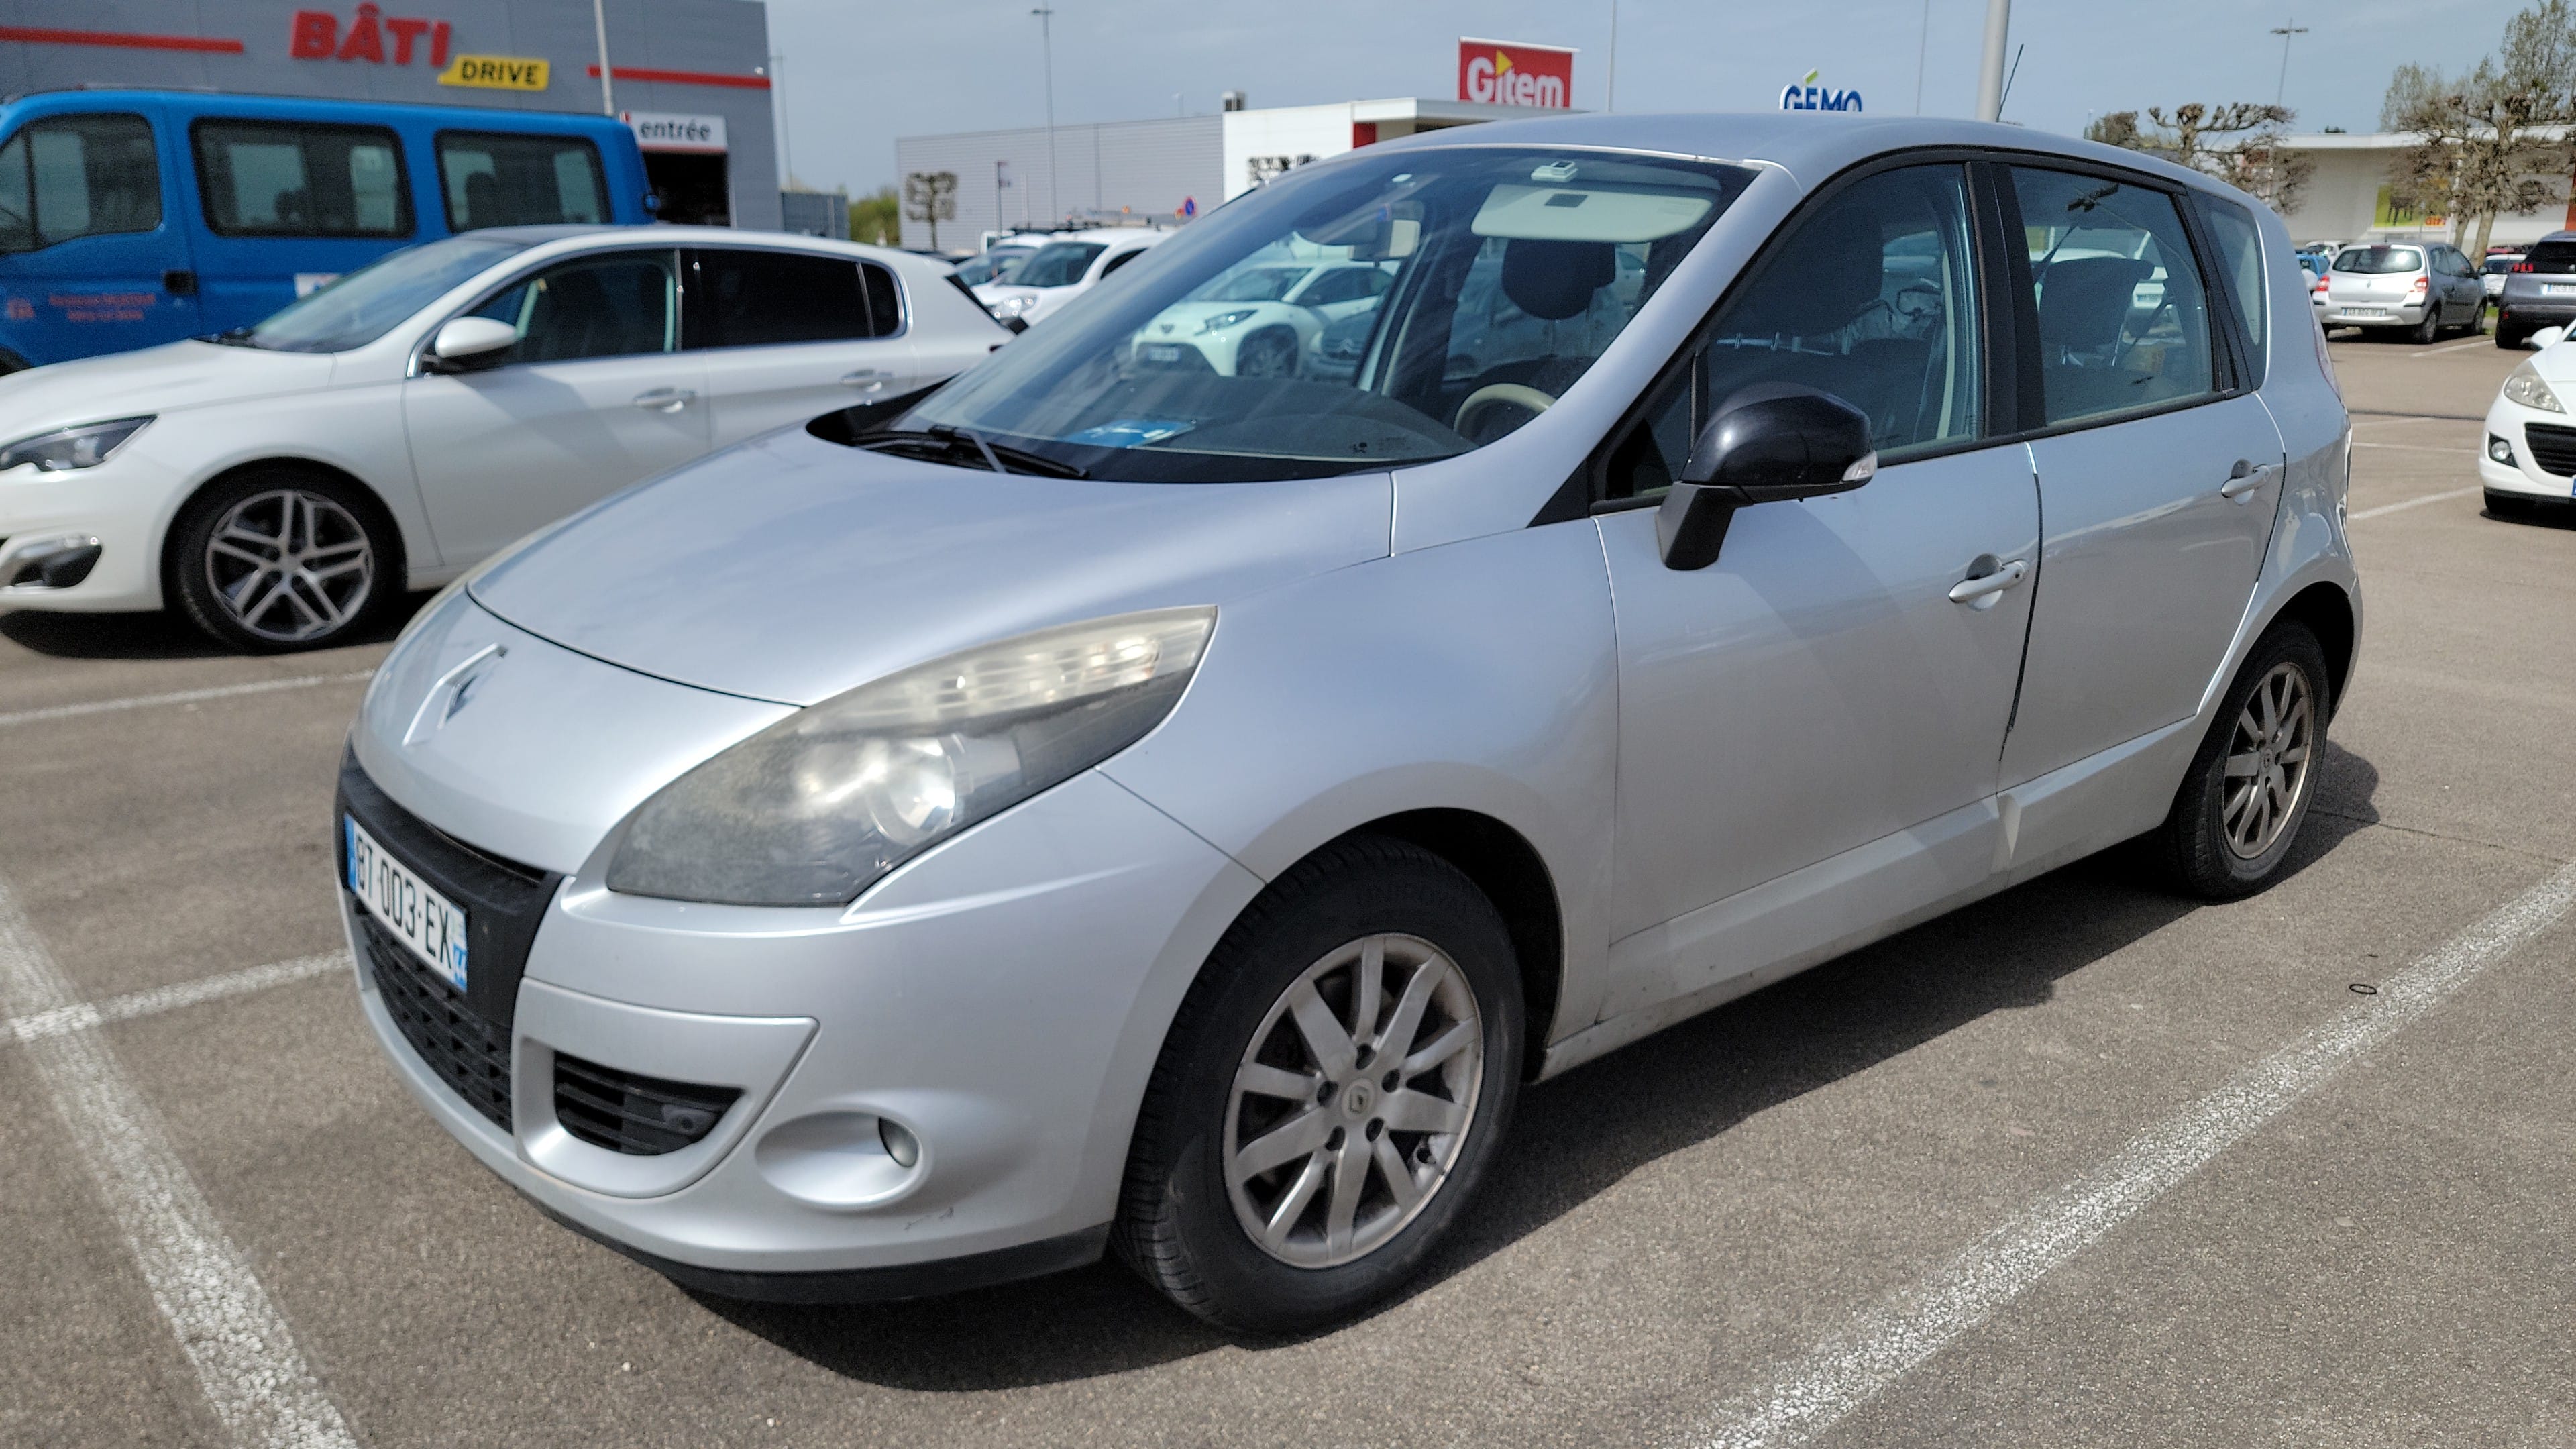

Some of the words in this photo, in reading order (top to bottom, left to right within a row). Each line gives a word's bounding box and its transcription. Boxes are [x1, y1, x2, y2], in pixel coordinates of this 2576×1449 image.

[290, 1, 451, 68] BÂTI
[461, 60, 537, 86] DRIVE
[1466, 49, 1564, 108] Gitem
[1780, 68, 1862, 113] GÉMO
[640, 119, 711, 142] entrée
